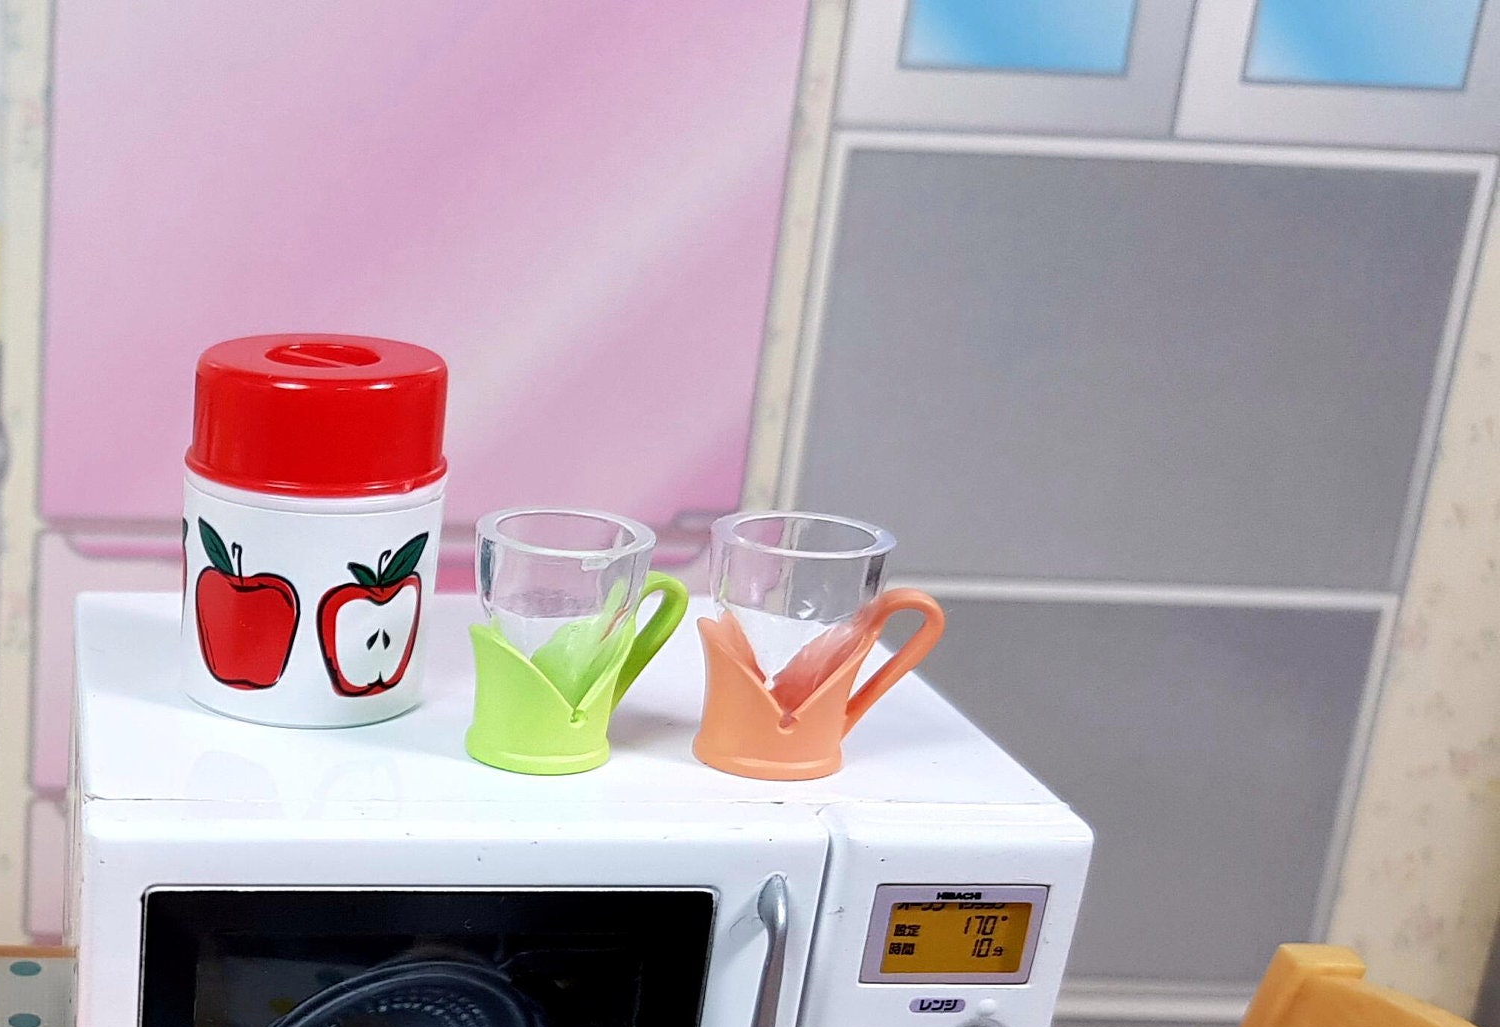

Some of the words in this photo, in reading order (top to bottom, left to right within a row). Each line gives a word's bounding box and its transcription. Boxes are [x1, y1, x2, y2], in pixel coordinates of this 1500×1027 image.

[936, 892, 982, 900] HIBACHI
[893, 924, 921, 937] 設定
[888, 943, 915, 956] 時間
[919, 1000, 958, 1011] レンジ
